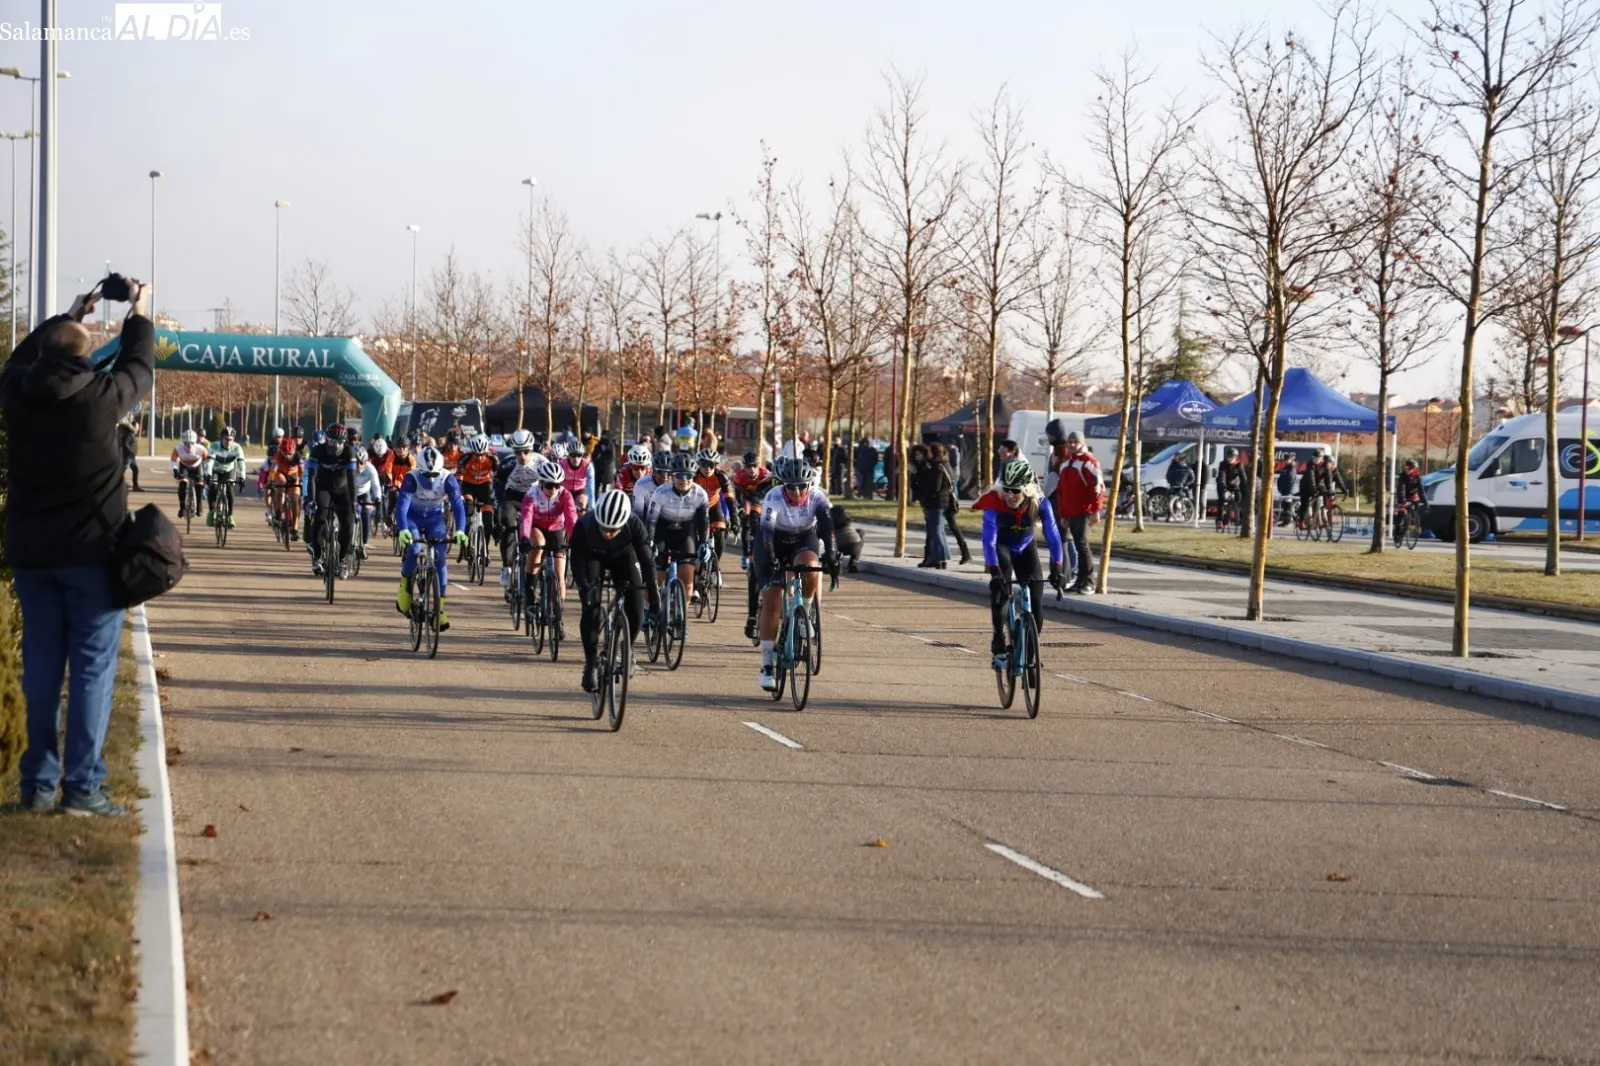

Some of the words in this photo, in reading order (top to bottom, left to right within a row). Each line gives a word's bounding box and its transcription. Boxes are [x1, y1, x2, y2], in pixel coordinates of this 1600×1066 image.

[182, 344, 244, 369] CAJA
[251, 346, 336, 369] RURAL
[1288, 417, 1361, 427] bacalaobueno.es
